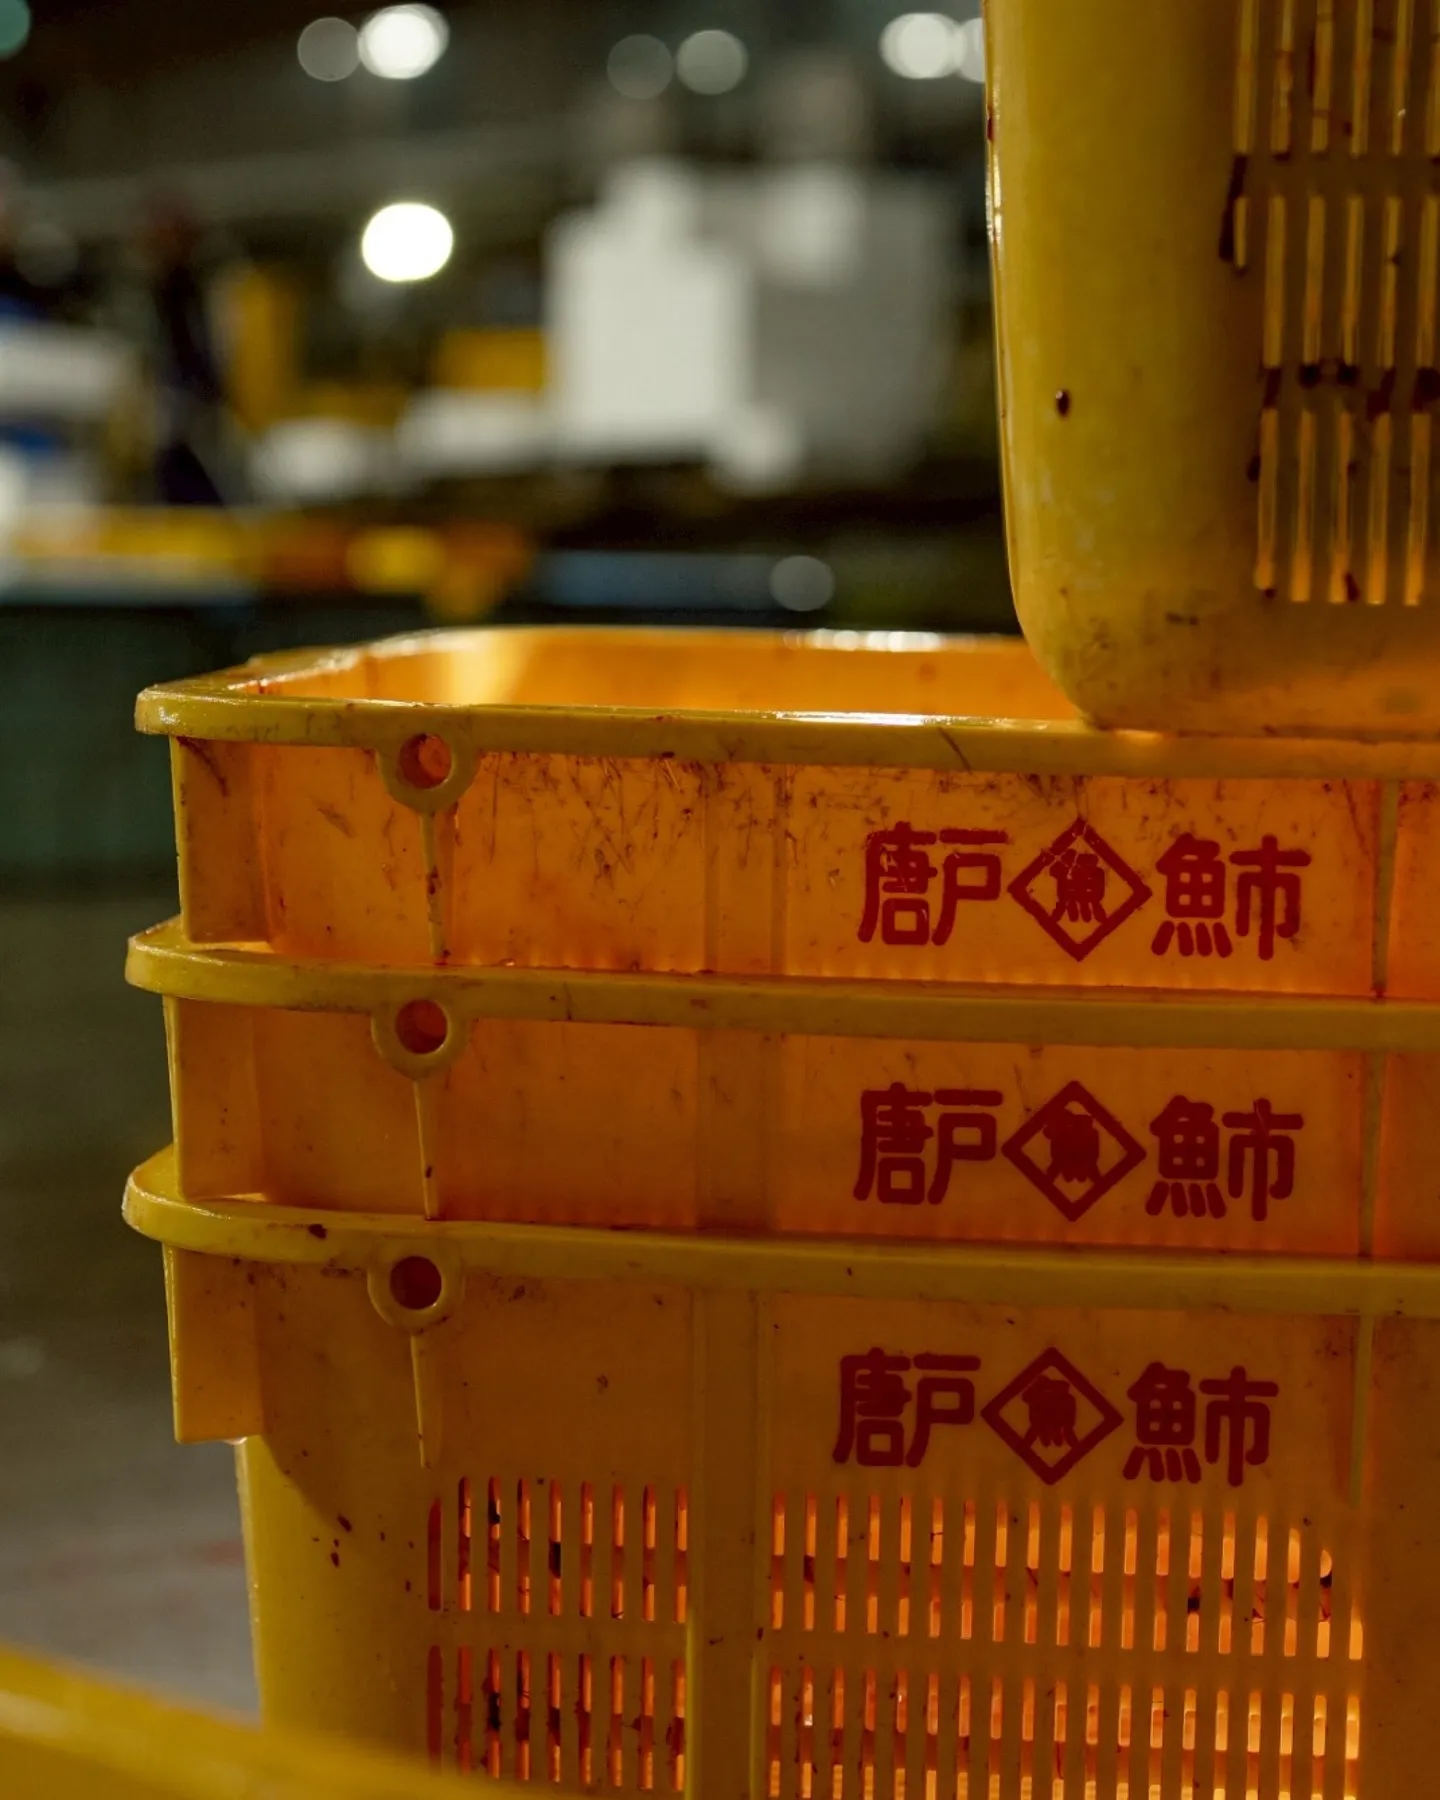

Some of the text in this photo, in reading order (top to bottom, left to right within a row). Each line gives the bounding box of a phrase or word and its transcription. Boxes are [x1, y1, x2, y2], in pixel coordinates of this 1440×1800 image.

[857, 821, 1008, 945] 唐戸
[1151, 832, 1311, 960] 魚市
[853, 1082, 1003, 1205] 唐戸
[1145, 1095, 1304, 1222] 魚市
[832, 1347, 981, 1468] 唐戸
[1123, 1362, 1279, 1487] 魚市
